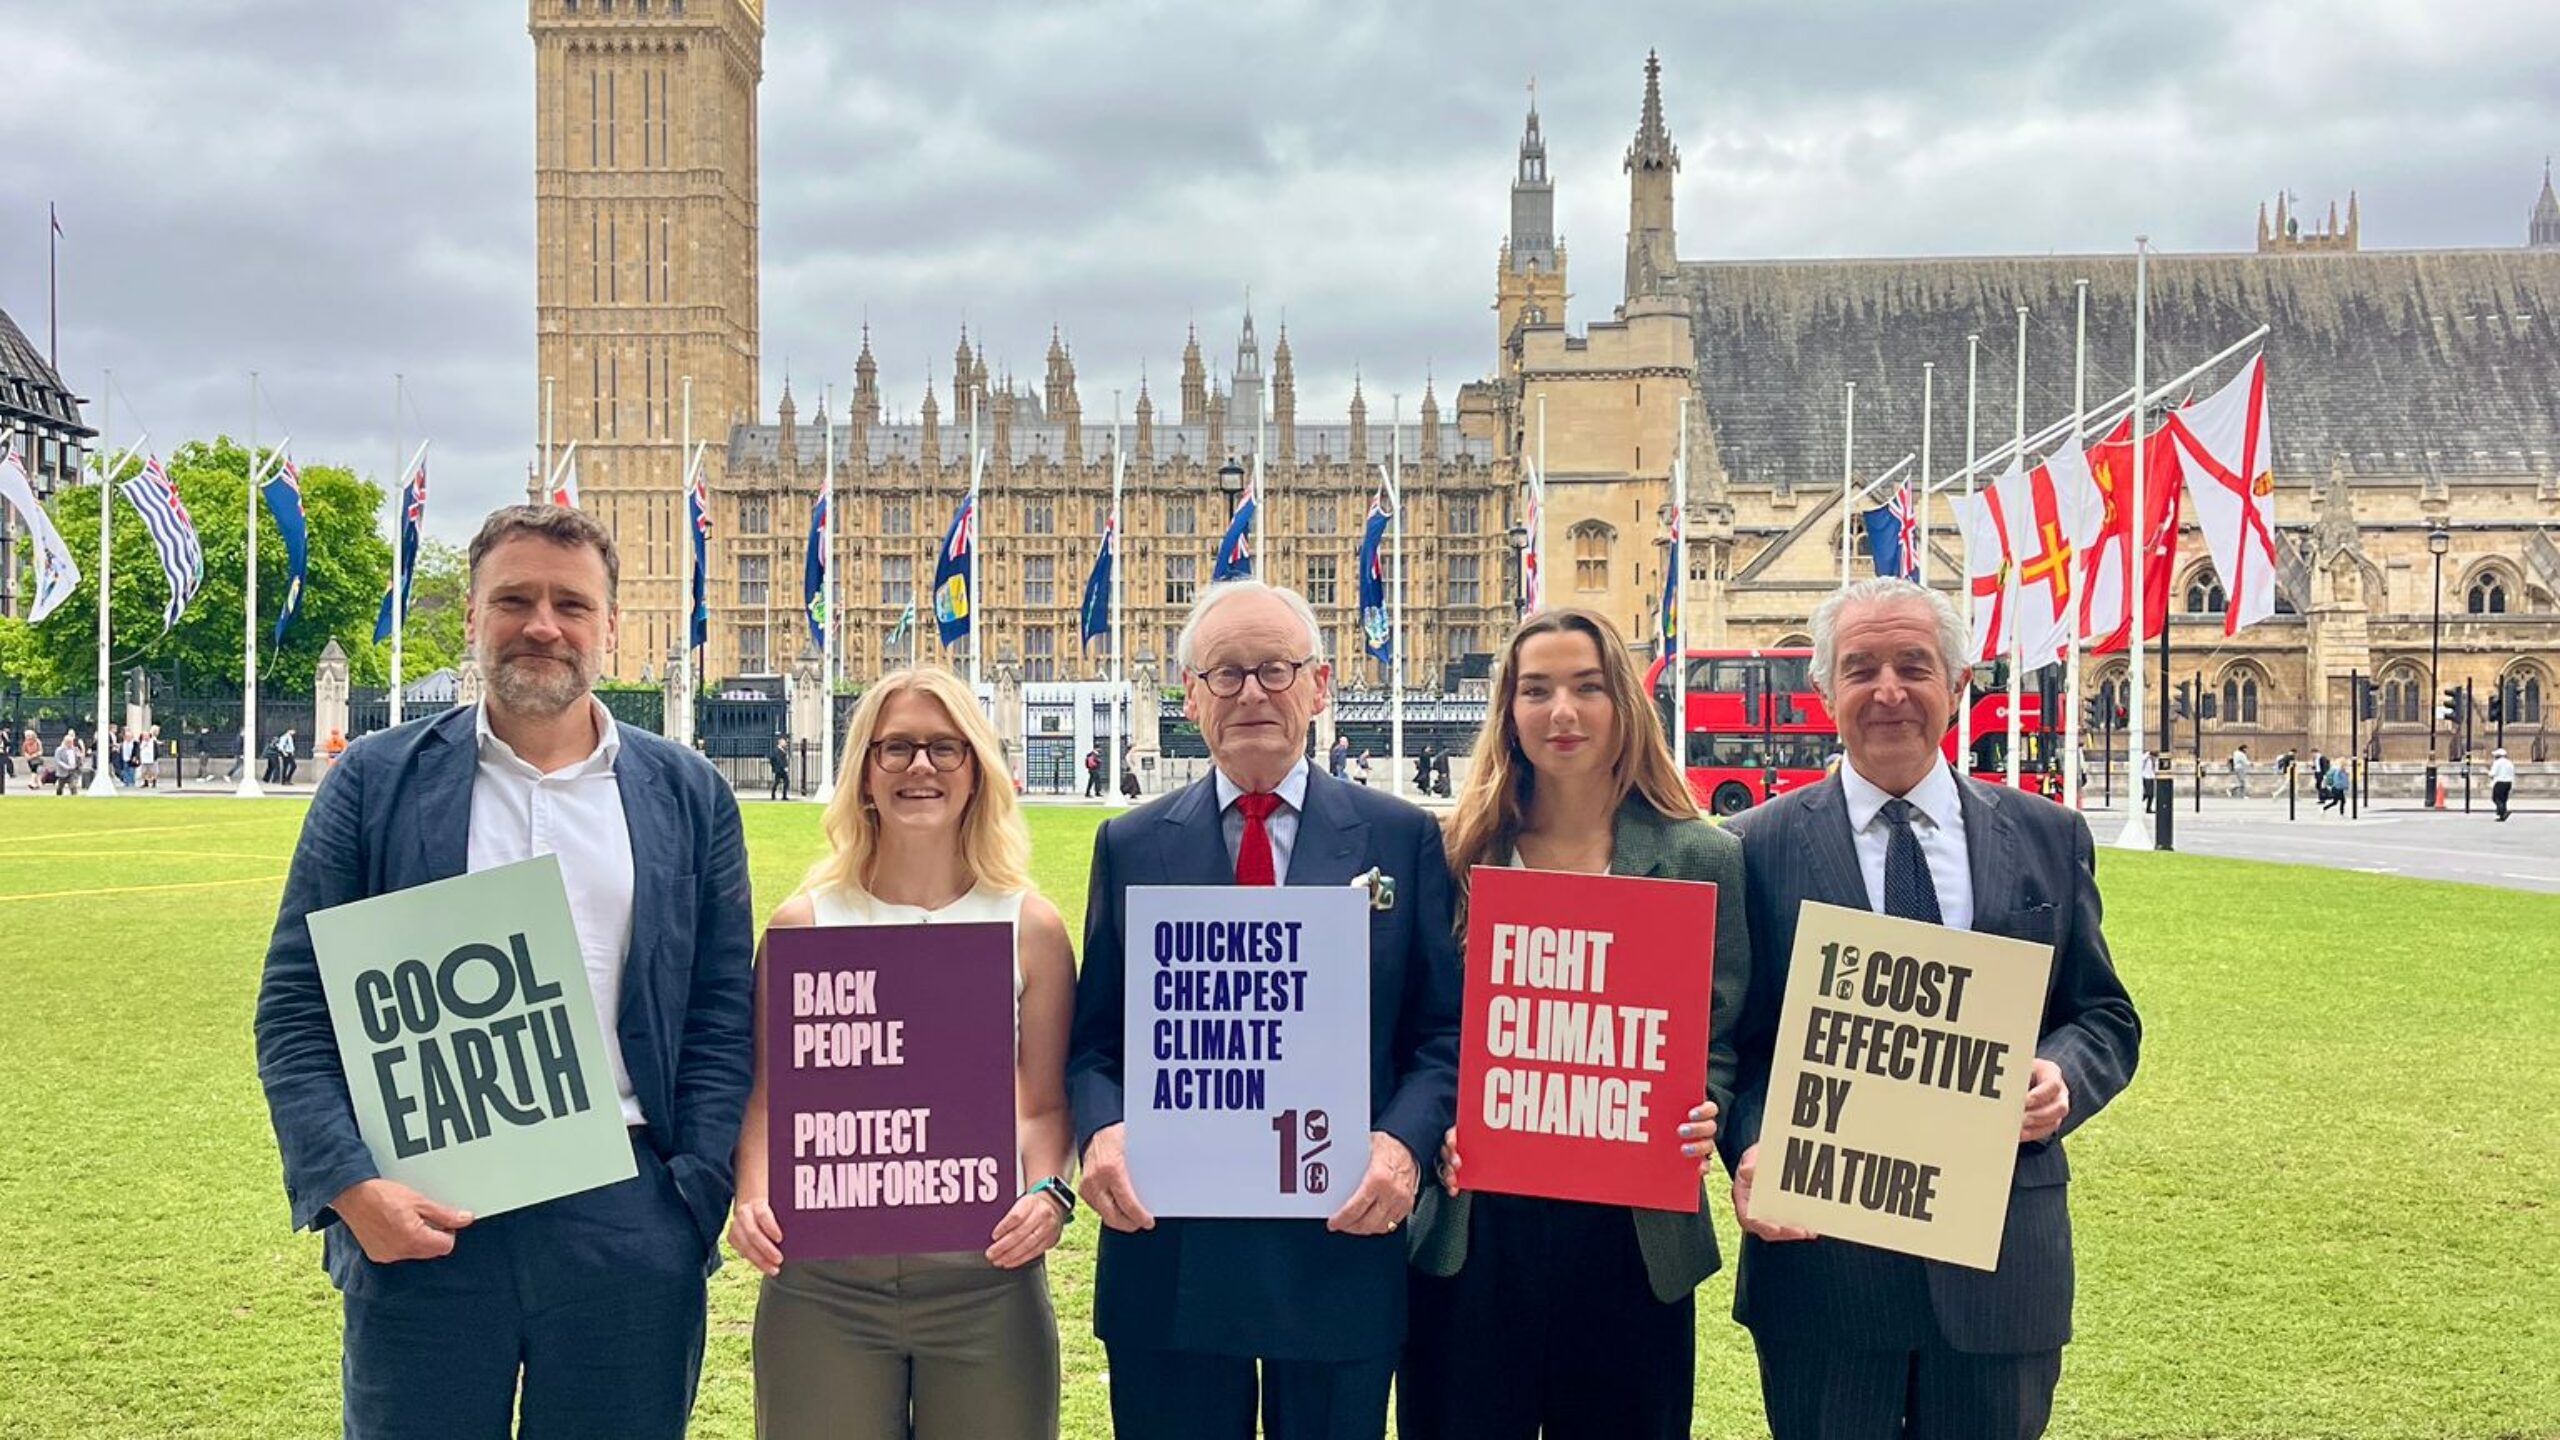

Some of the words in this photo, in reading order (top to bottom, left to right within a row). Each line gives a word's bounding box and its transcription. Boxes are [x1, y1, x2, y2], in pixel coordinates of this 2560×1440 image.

[1154, 921, 1302, 967] QUICKEST
[1491, 923, 1614, 993] FIGHT
[354, 932, 563, 1044] COOL
[793, 970, 877, 1016] BACK
[1154, 970, 1307, 1012] CHEAPEST
[1861, 951, 1973, 1023] COST
[793, 1021, 904, 1068] PEOPLE
[1154, 1019, 1282, 1060] CLIMATE
[1487, 995, 1669, 1072] CLIMATE
[1802, 1006, 2009, 1099] EFFECTIVE
[371, 1003, 591, 1160] EARTH
[1153, 1068, 1265, 1110] ACTION
[1483, 1067, 1652, 1143] CHANGE
[1791, 1071, 1852, 1134] BY
[794, 1108, 930, 1157] PROTECT
[794, 1156, 998, 1210] RAINFORESTS
[1780, 1136, 1941, 1222] NATURE
